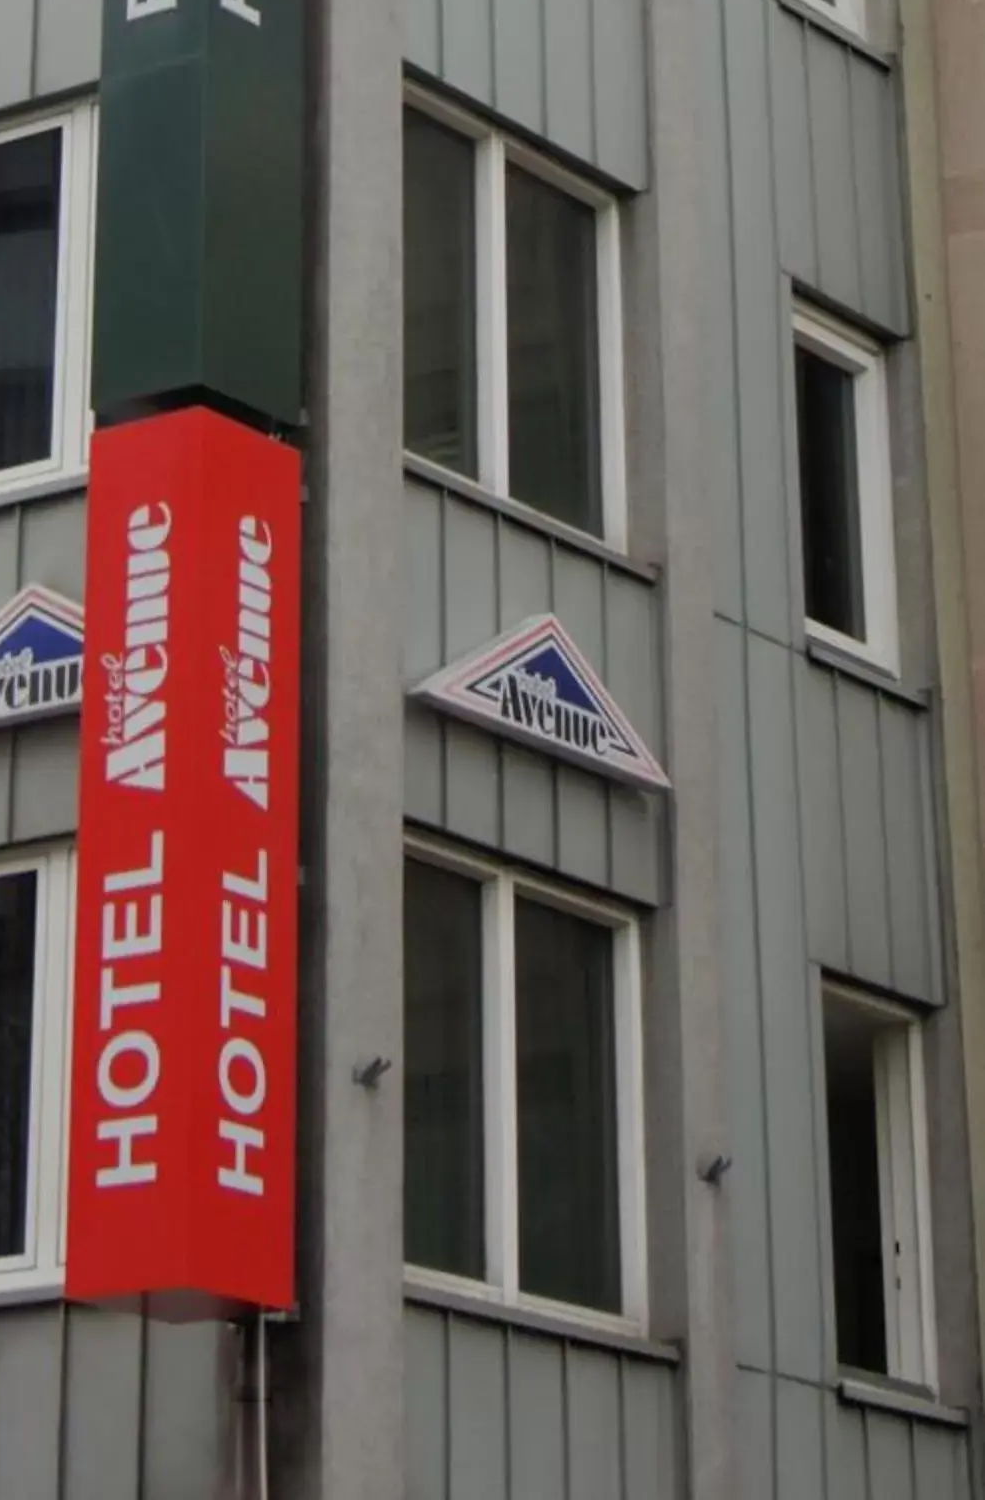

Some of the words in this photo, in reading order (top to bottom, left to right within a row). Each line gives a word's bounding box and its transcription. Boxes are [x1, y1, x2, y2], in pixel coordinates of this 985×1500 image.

[100, 652, 123, 746] hotel
[106, 501, 172, 792] Avenue
[217, 644, 239, 744] hotel
[223, 514, 273, 811] Avenue
[500, 673, 610, 755] Avenue
[96, 829, 164, 1189] HOTEL
[217, 848, 268, 1196] HOTEL
